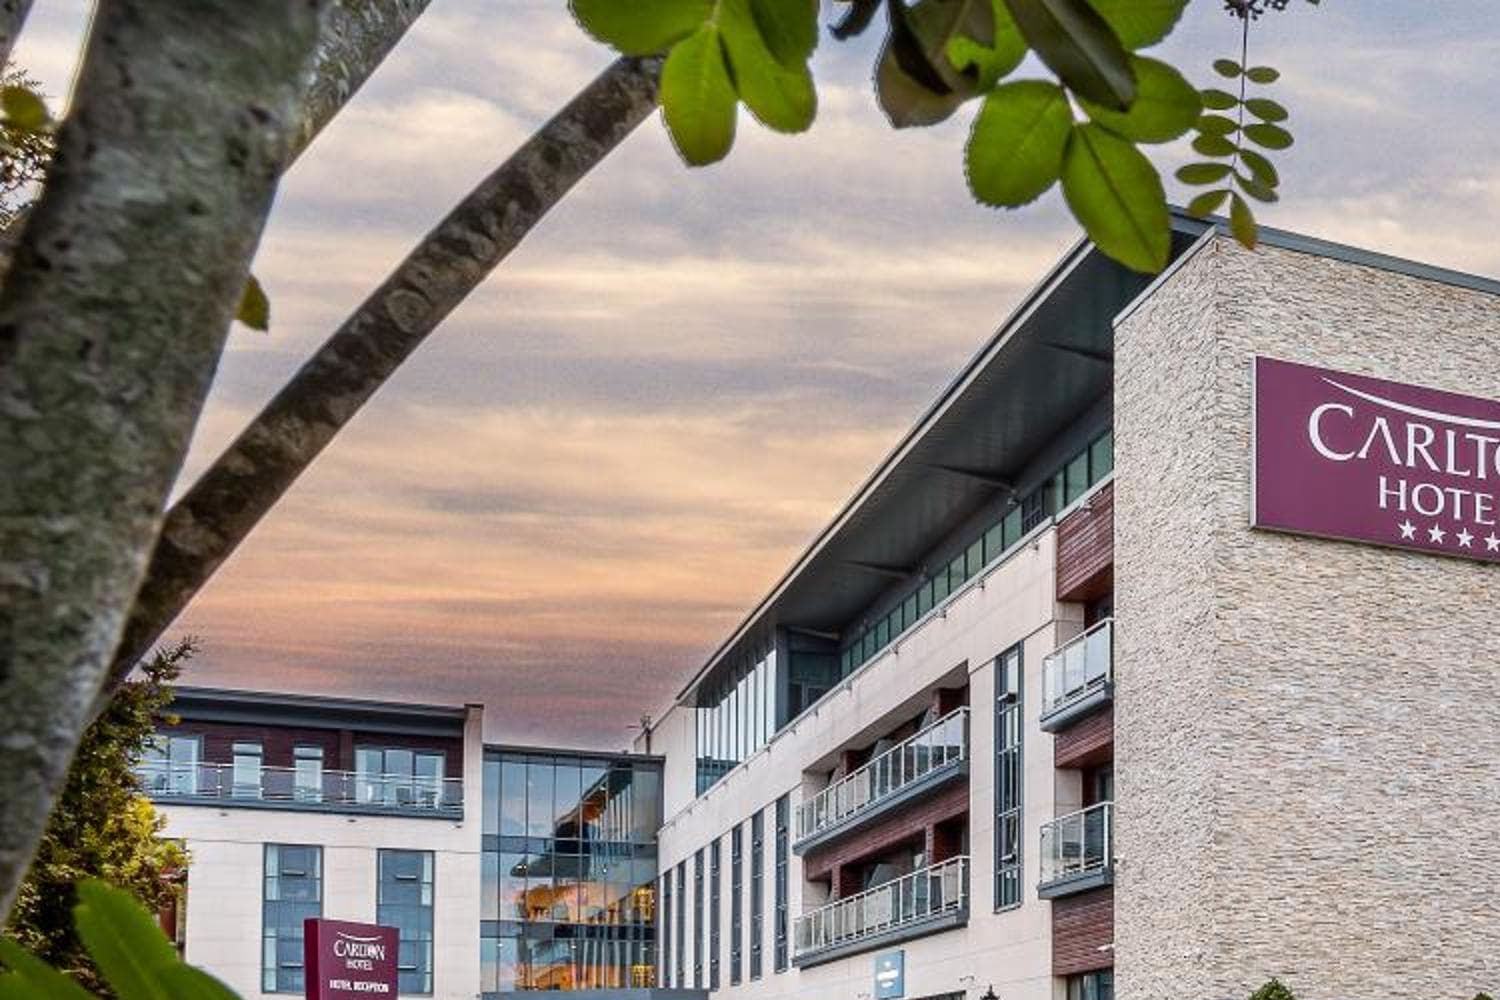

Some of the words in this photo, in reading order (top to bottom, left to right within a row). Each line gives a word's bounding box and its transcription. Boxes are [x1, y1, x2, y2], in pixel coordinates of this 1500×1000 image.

[333, 939, 385, 961] CARLTON
[345, 959, 373, 971] HOTEL
[329, 979, 352, 991] HOTEL
[353, 981, 390, 993] RECEPTION
